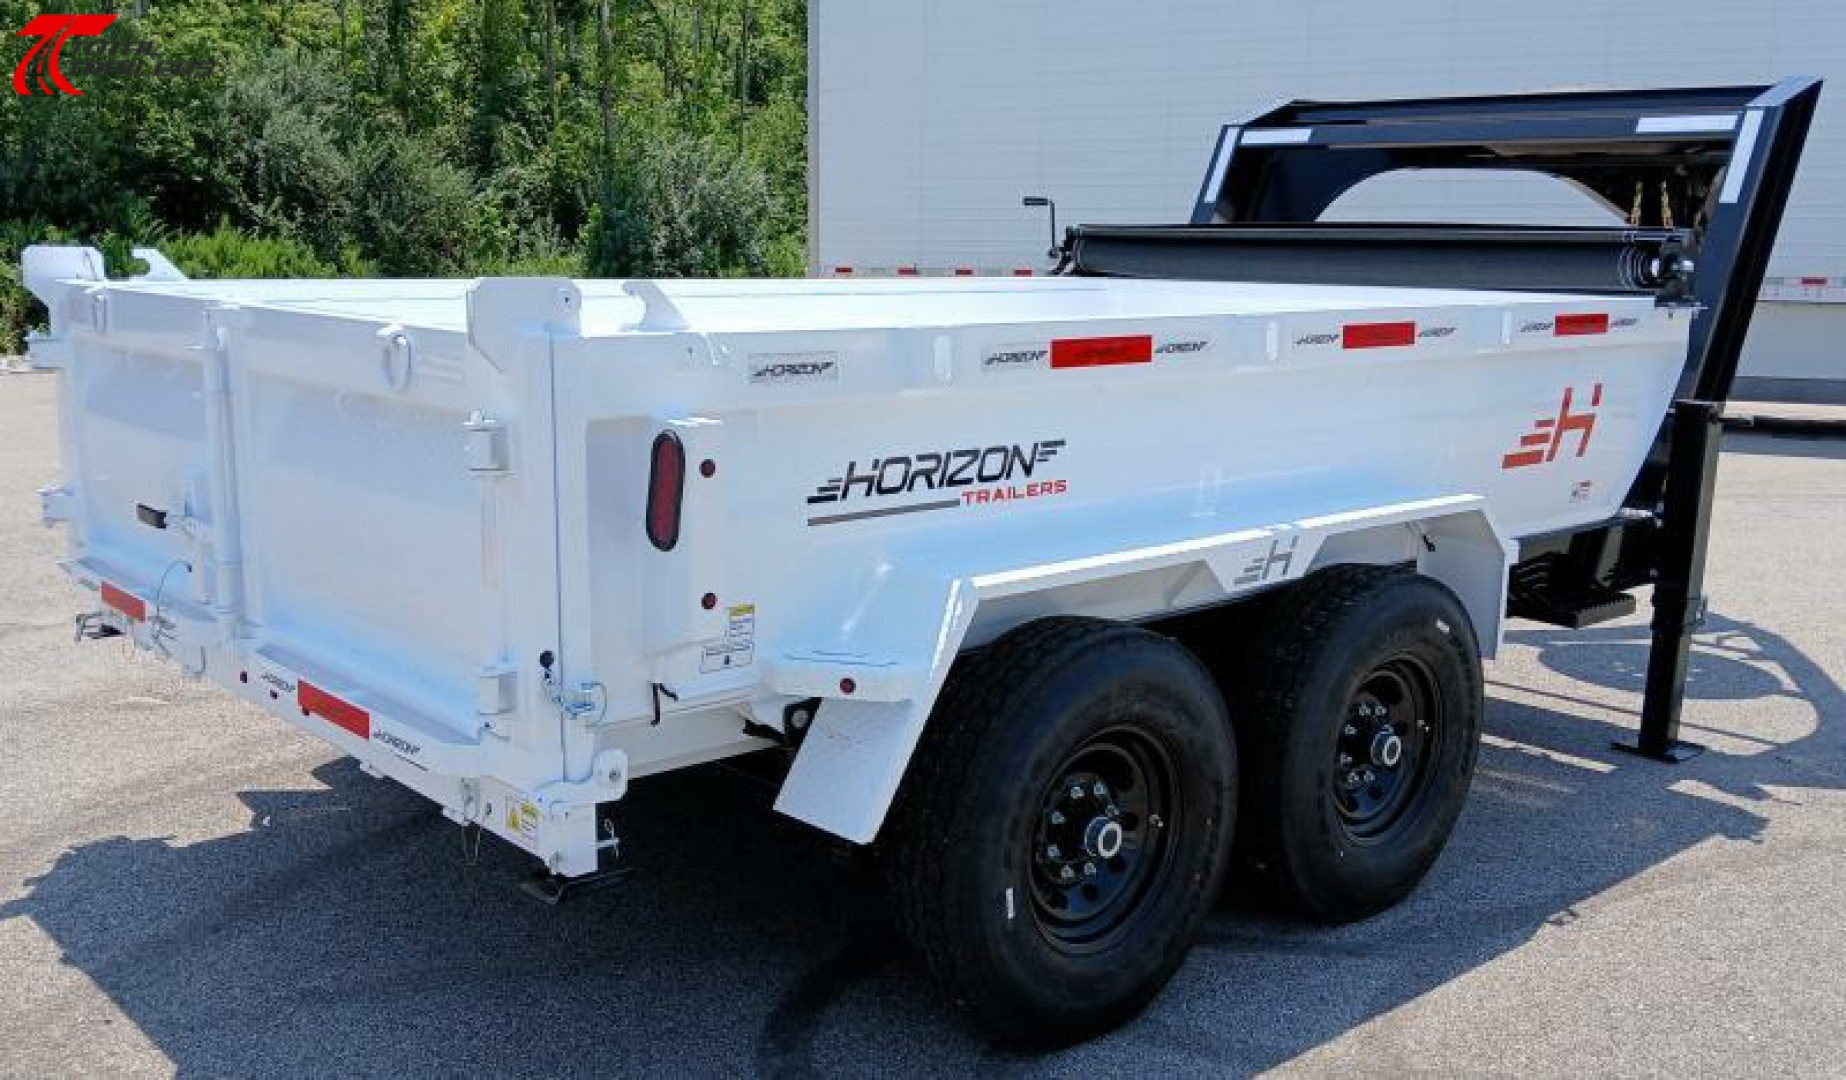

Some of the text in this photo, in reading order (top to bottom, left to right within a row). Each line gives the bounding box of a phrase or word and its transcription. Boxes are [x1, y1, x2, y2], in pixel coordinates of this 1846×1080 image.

[758, 361, 829, 378] HORIZON
[836, 440, 1044, 501] HORIZON
[962, 479, 1067, 505] TRAILERS
